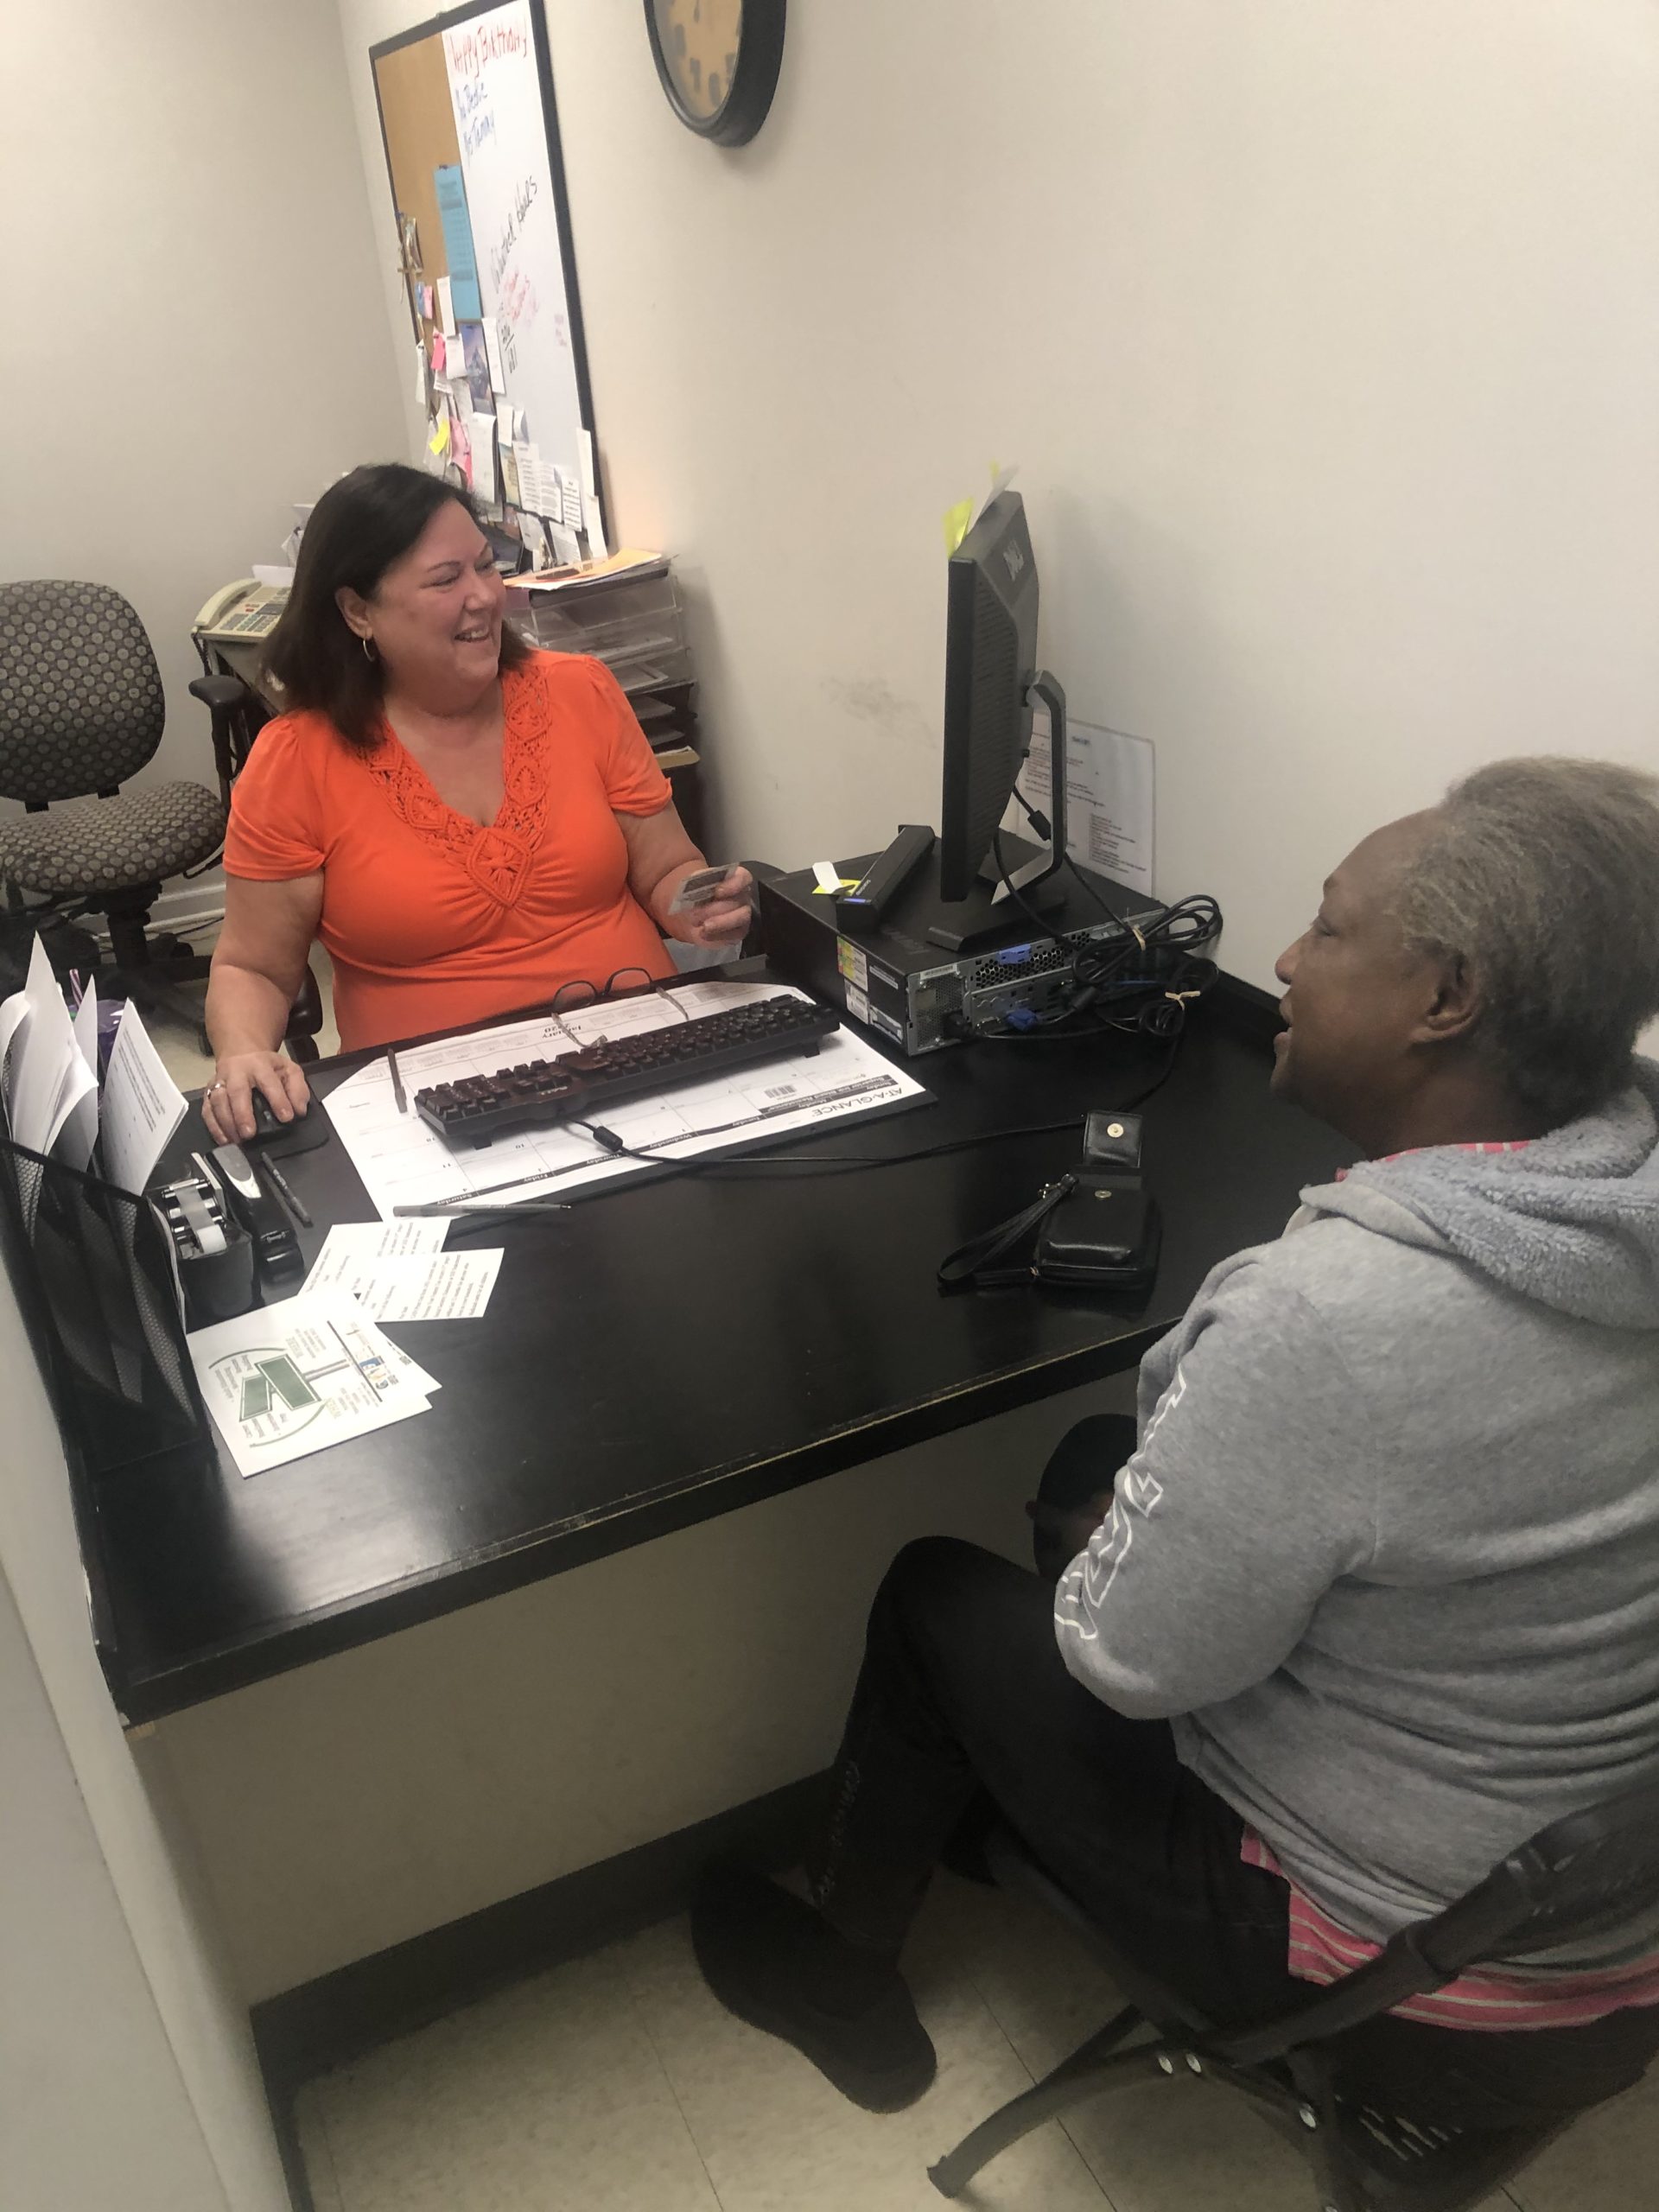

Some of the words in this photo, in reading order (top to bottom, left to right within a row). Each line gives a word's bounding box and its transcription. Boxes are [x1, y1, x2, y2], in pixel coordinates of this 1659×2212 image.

[867, 1081, 892, 1090] Sunday
[798, 1098, 827, 1109] Monday
[732, 1116, 760, 1127] Tuesday
[649, 1134, 692, 1148] Wednesday
[586, 1153, 622, 1166] Thursday
[524, 1173, 549, 1183] Friday
[437, 1193, 473, 1205] Saturday
